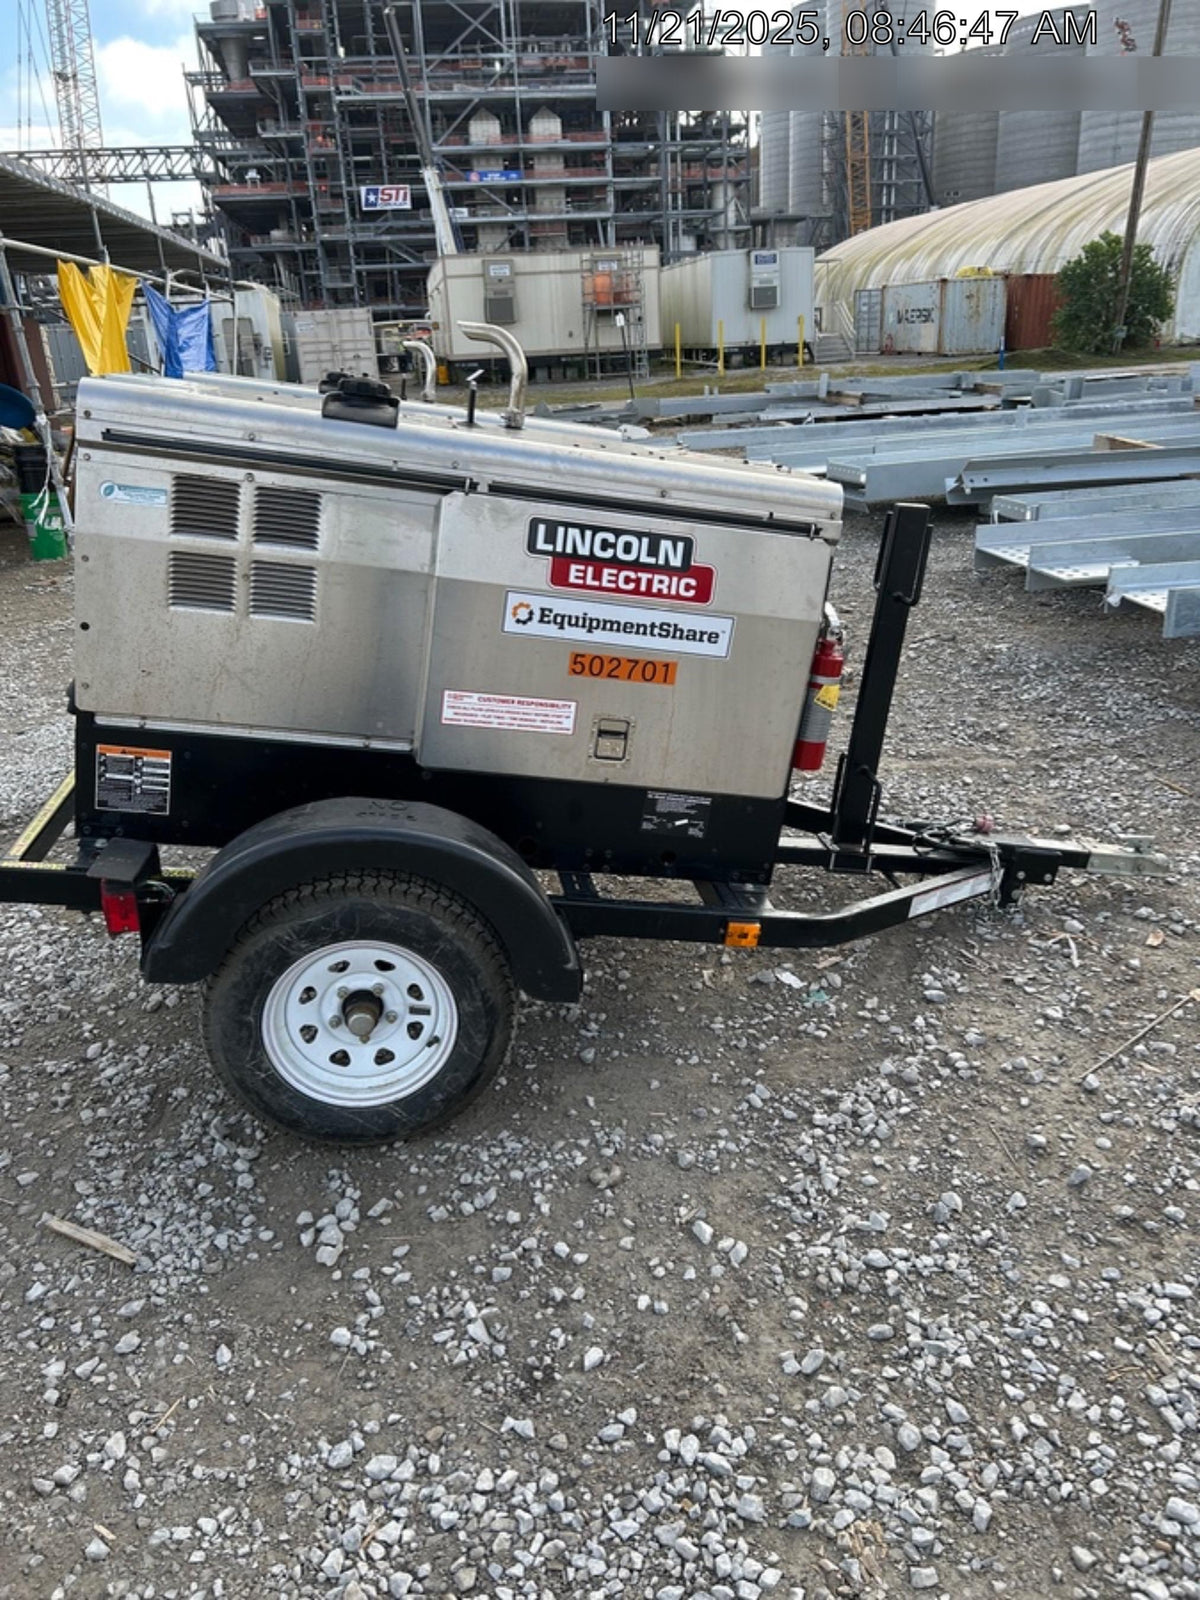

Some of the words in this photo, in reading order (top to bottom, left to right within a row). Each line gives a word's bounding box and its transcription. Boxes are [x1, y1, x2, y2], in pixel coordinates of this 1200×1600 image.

[536, 523, 685, 567] LINCOLN
[568, 563, 698, 597] ELECTRIC
[538, 607, 720, 645] EquipmentShare
[571, 653, 672, 684] 502701
[477, 696, 515, 705] CUSTOMER
[516, 699, 572, 709] RESPONSIBILITY
